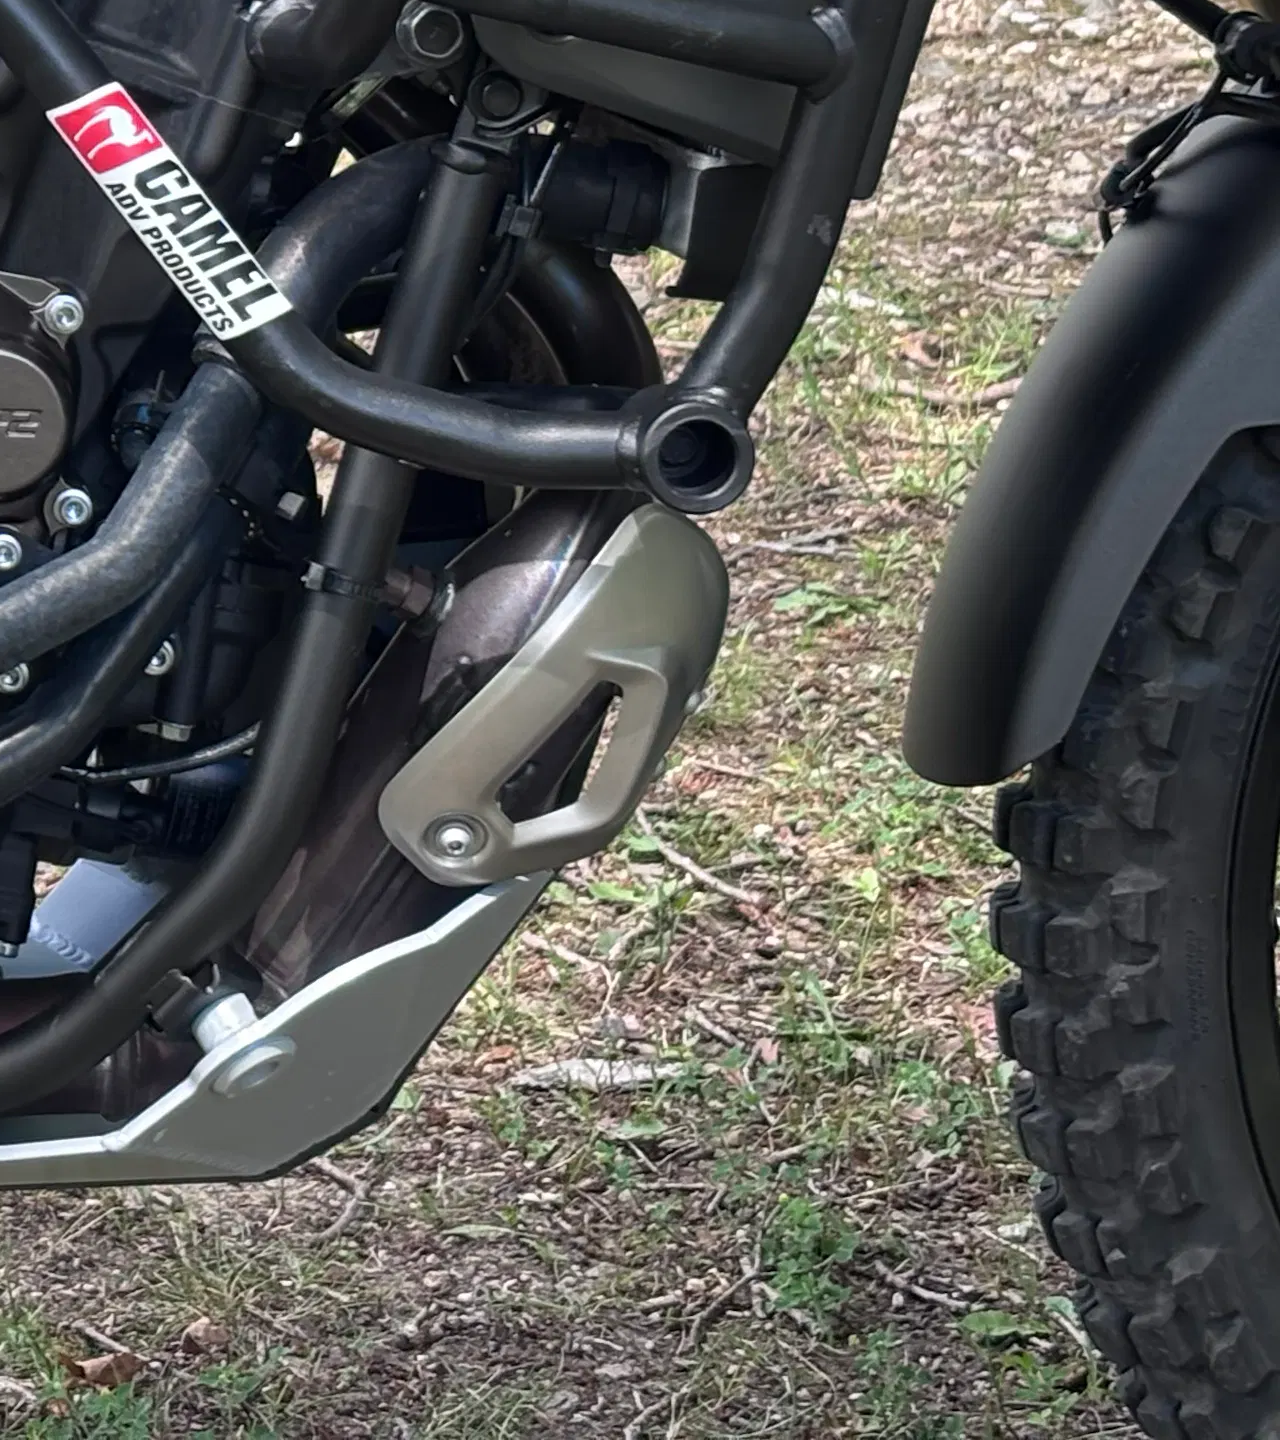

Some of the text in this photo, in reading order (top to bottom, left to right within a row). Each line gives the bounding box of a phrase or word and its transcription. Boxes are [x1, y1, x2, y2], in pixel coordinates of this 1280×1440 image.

[103, 181, 235, 333] ADV PRODUCTS
[134, 159, 278, 322] CAMEL
